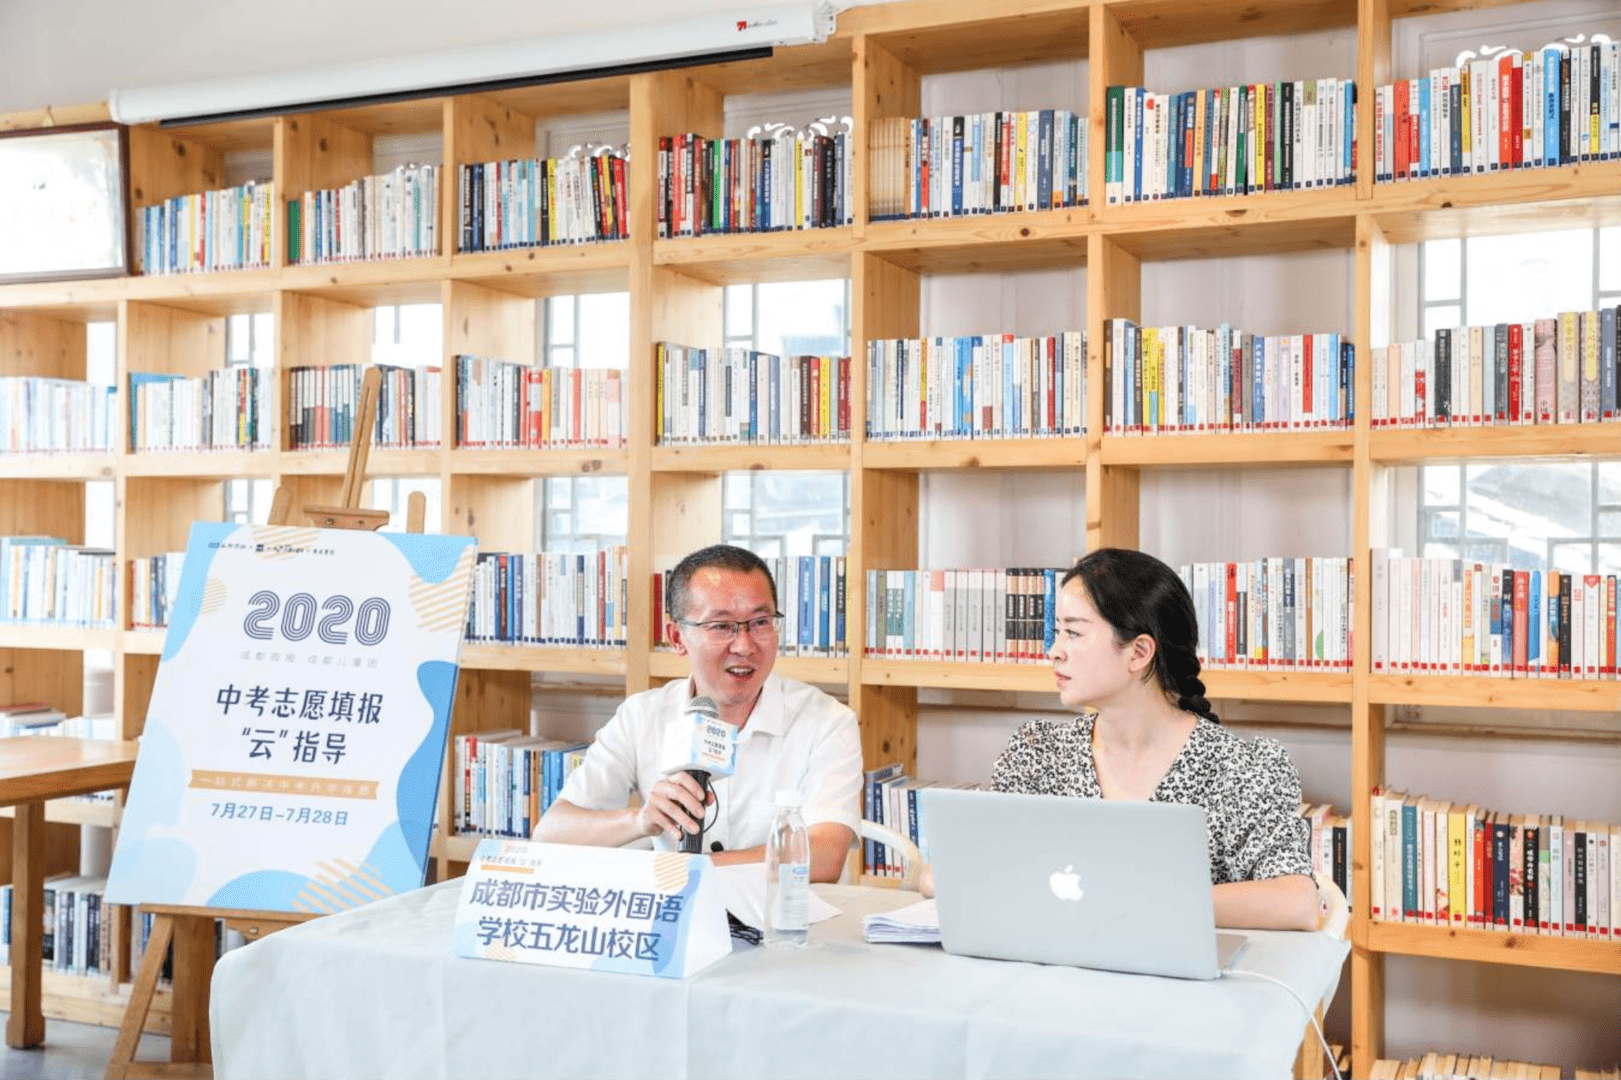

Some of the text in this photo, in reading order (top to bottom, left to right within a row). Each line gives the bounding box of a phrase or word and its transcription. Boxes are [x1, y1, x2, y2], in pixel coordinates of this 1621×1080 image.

[243, 590, 391, 646] 2020
[216, 684, 384, 725] 中考志愿填报
[469, 878, 685, 923] 成都市实验外国语
[476, 915, 662, 961] 学校五龙山校区
